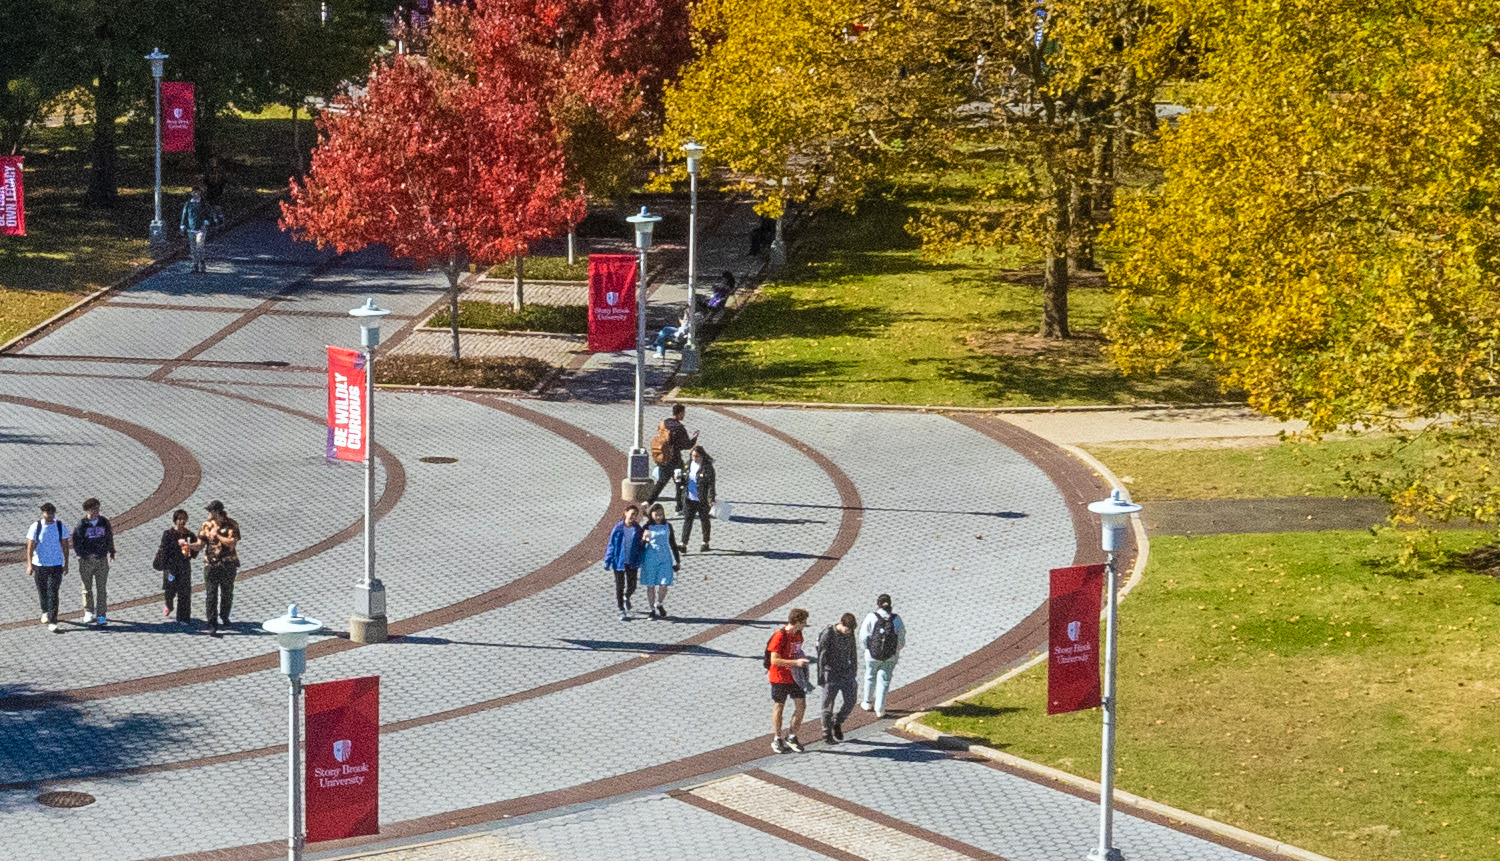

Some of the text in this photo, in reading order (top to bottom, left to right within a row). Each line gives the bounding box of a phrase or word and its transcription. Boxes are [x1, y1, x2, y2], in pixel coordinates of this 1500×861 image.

[5, 165, 17, 227] OWN LEGACY
[334, 372, 349, 447] BE WILDLY
[347, 385, 362, 450] CURIOUS
[315, 763, 369, 777] Stony Brook
[319, 775, 364, 788] University
